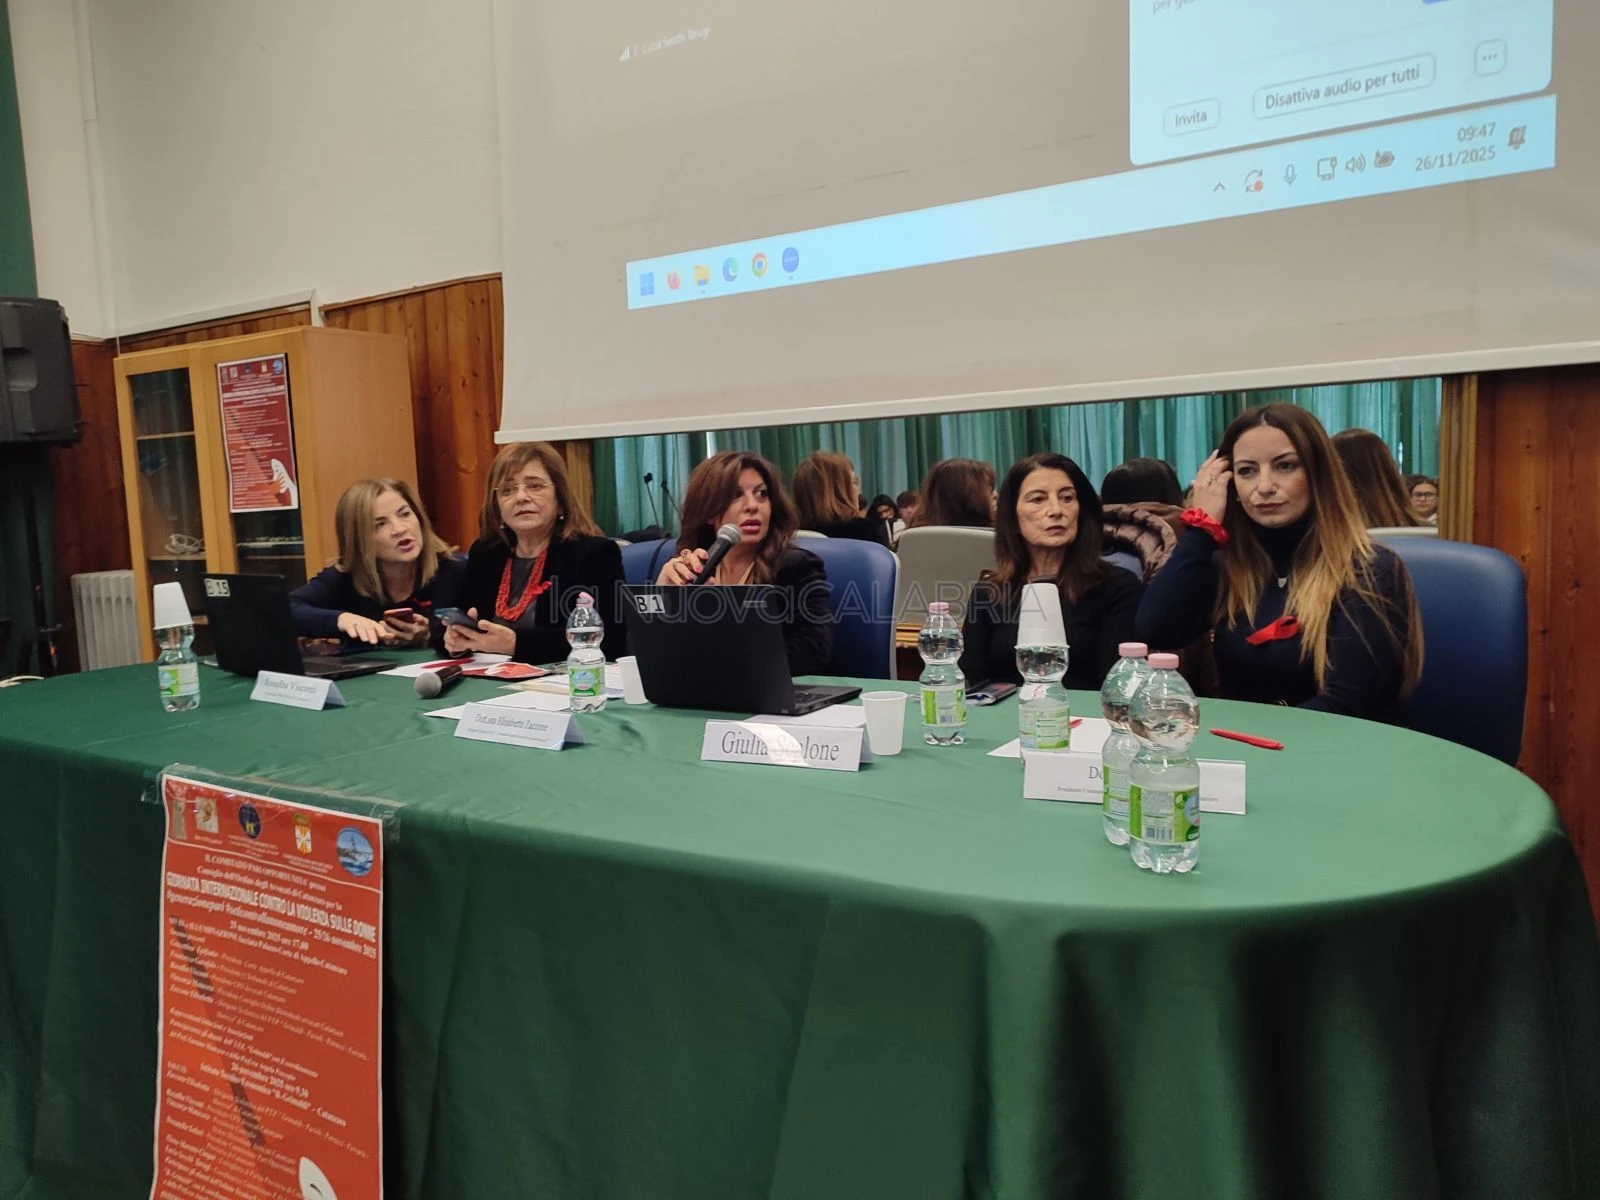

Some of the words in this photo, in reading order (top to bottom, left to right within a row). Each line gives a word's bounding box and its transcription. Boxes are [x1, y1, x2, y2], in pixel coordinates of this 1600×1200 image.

[1265, 86, 1321, 110] Disattiva
[1323, 77, 1362, 97] audio
[1364, 74, 1388, 95] per
[1391, 64, 1420, 84] tutti
[1174, 108, 1208, 127] Invita
[1457, 122, 1497, 143] 09:47
[1415, 146, 1497, 173] 26/11/2025
[721, 730, 768, 756] Giulia
[286, 901, 295, 916] LA
[329, 913, 352, 932] SULLE
